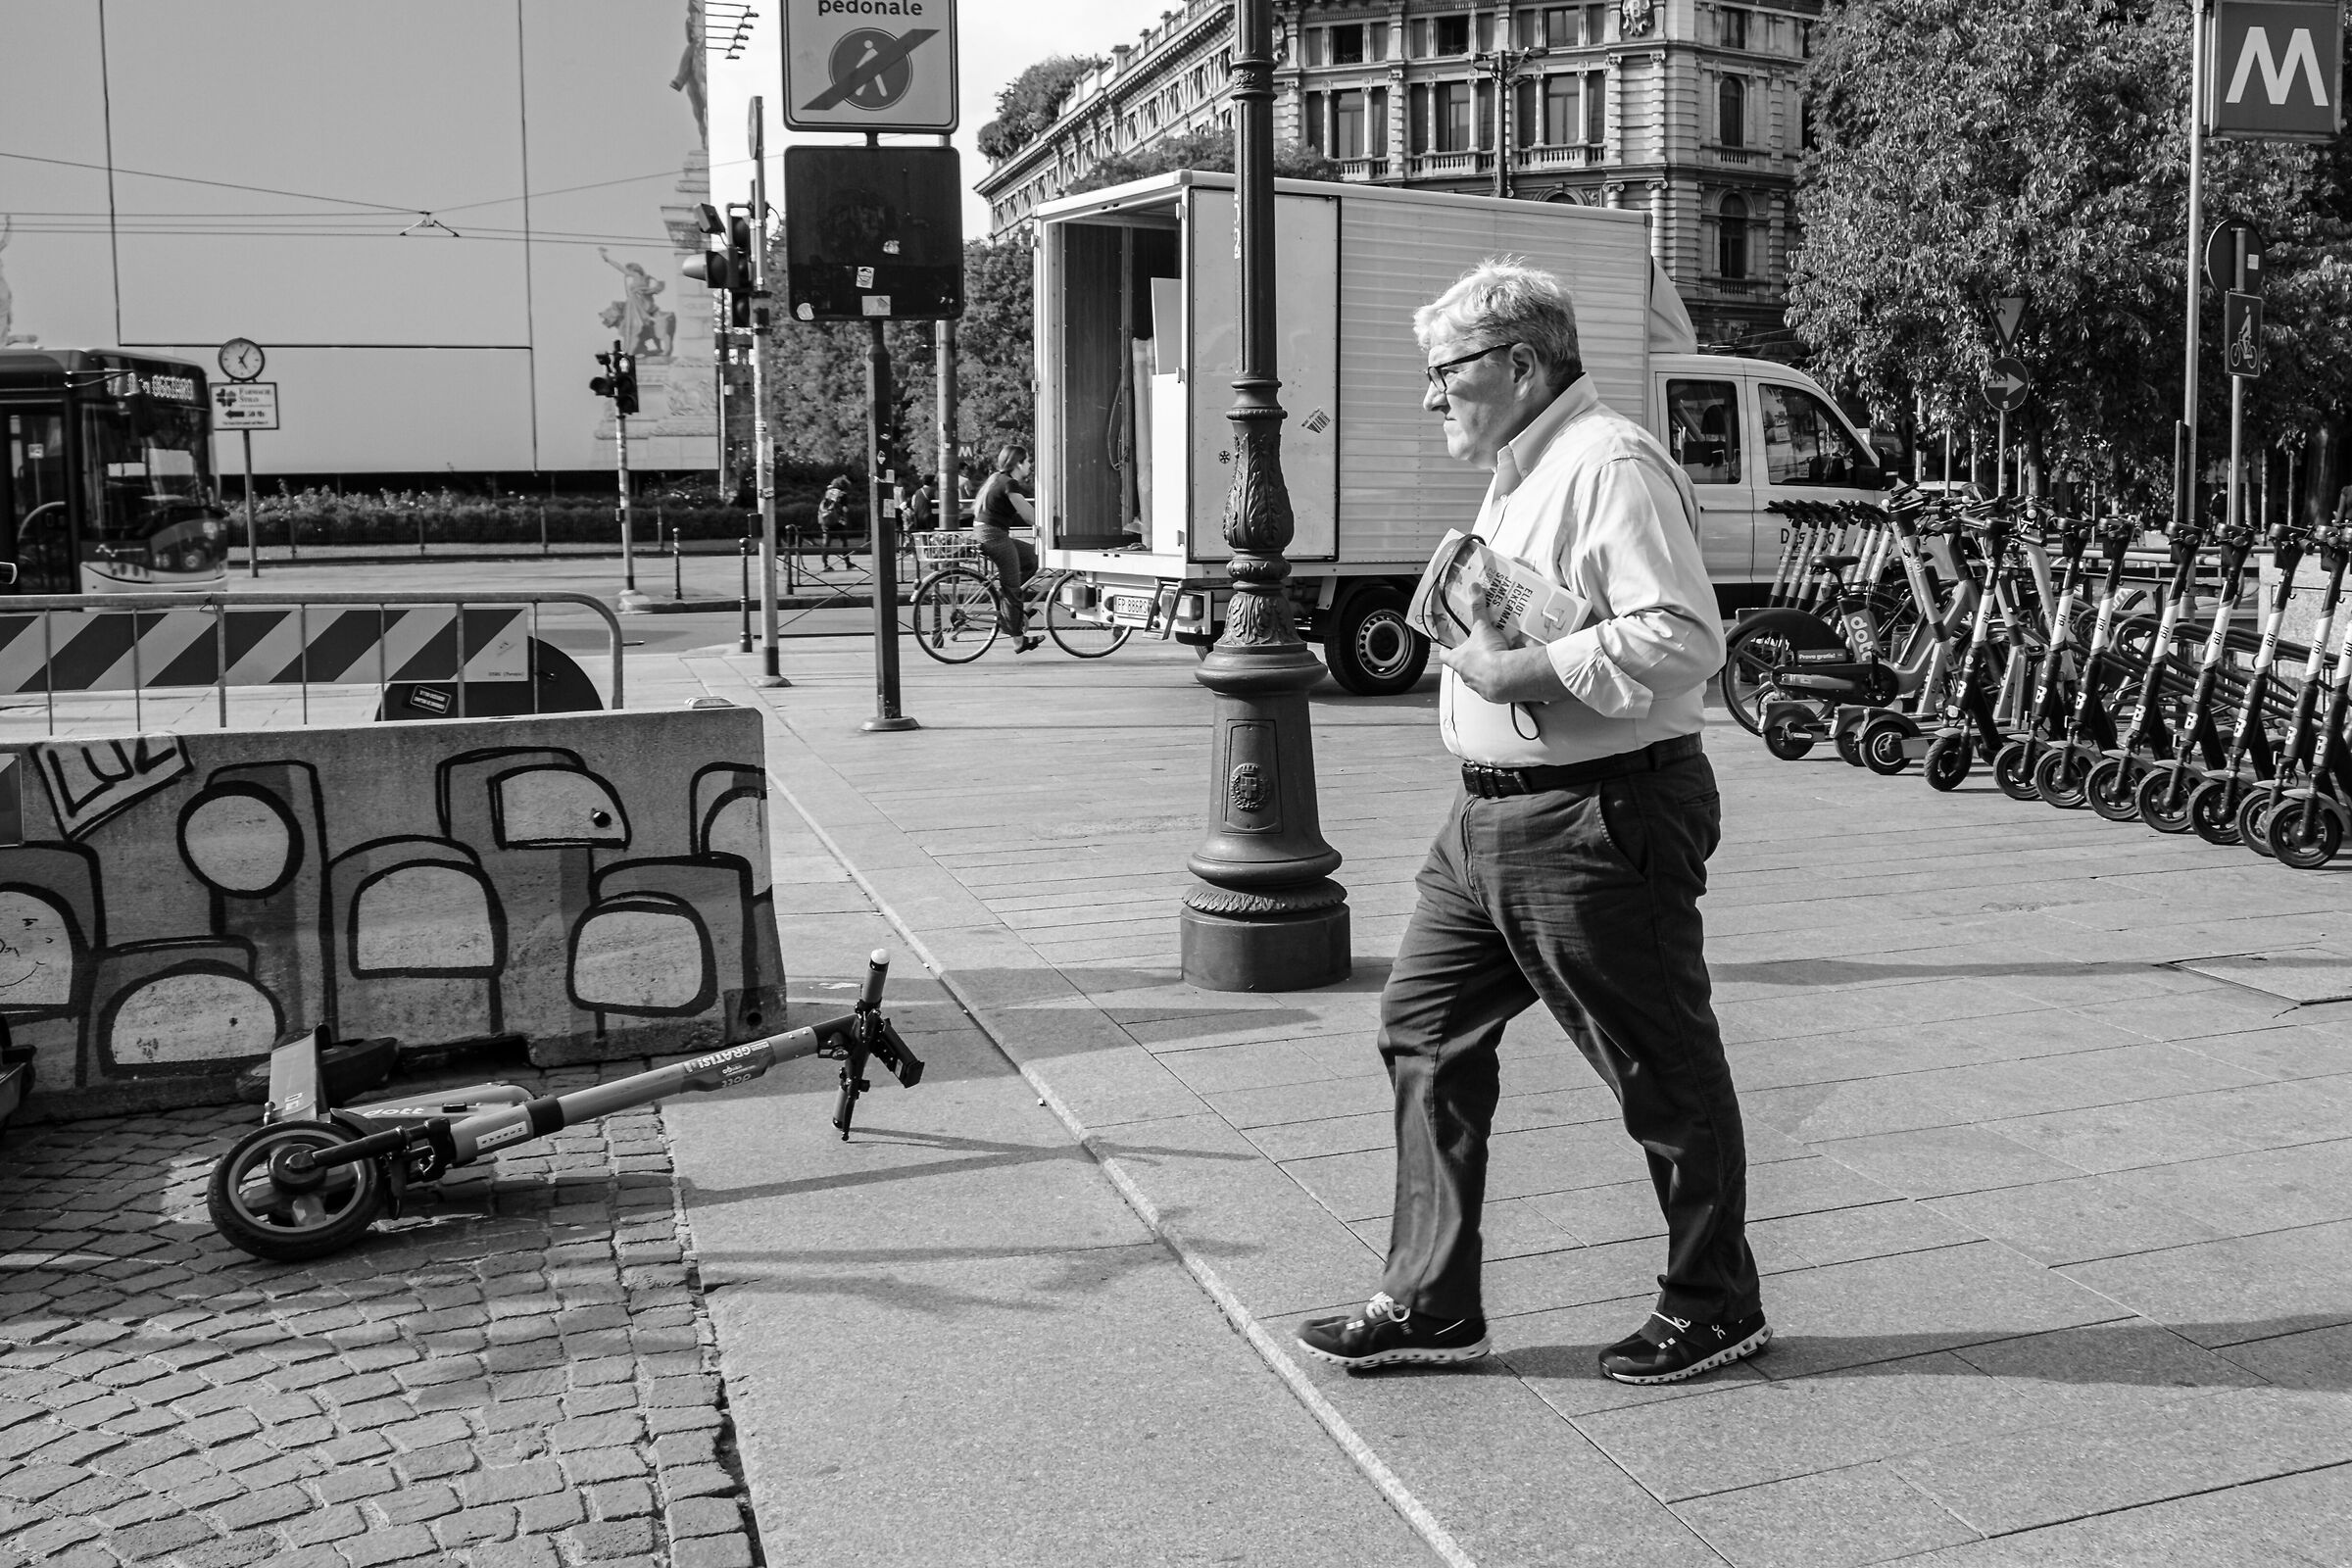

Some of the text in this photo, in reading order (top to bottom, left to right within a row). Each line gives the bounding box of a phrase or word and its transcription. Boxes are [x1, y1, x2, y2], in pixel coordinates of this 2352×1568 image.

[818, 0, 923, 16] pedonale
[2226, 26, 2328, 106] M
[1492, 576, 1512, 607] JAMES
[1513, 588, 1533, 616] ELLIOT
[1495, 583, 1524, 630] ACKERMAN
[1850, 616, 1875, 662] dott
[698, 1047, 752, 1068] GRATIS!
[363, 1107, 423, 1116] dott
